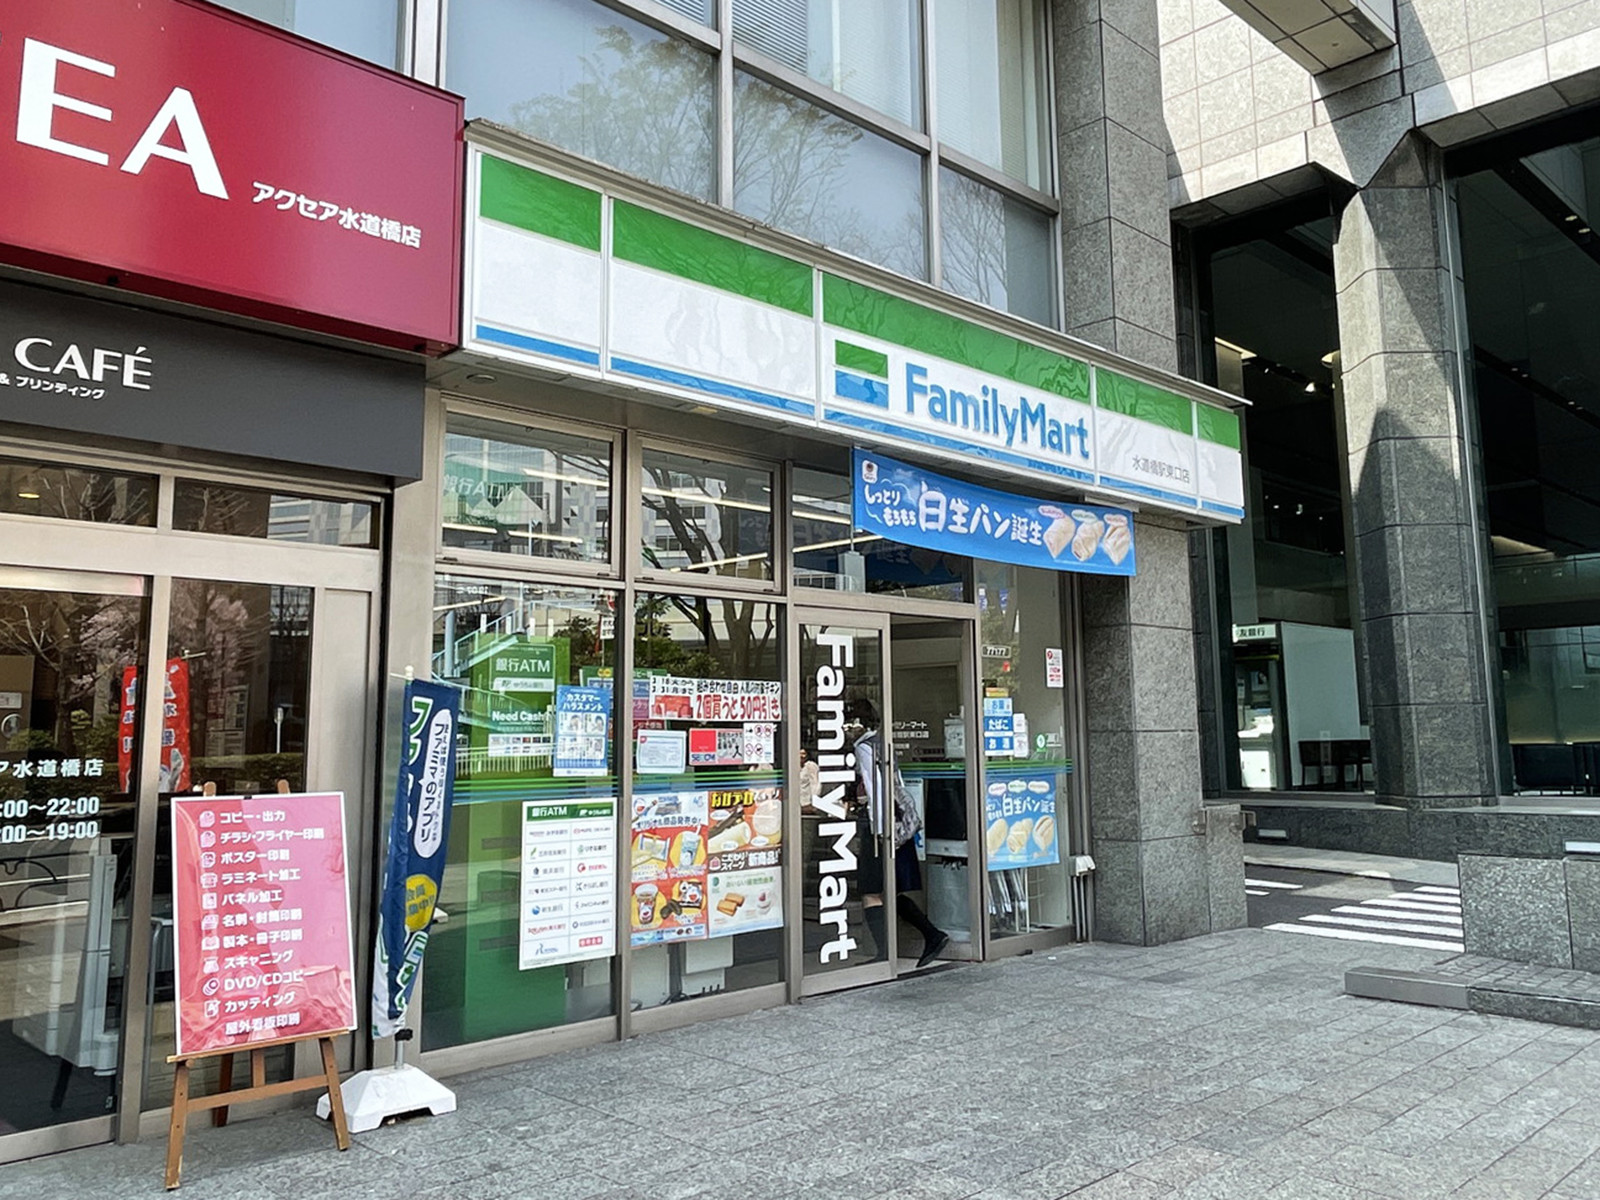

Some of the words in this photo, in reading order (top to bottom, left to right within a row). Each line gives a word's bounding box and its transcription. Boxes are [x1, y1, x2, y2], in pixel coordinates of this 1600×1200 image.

[16, 37, 230, 200] EA
[252, 181, 422, 249] アクセア水道橋店
[14, 337, 153, 390] CAFÉ
[15, 375, 106, 400] プリンティング
[904, 362, 1091, 460] FamilyMart
[864, 484, 901, 507] しっとり
[495, 657, 551, 672] 銀行ATM
[491, 710, 519, 722] Need
[562, 702, 604, 712] ハラスメント
[988, 719, 1010, 731] たばこ
[421, 722, 447, 843] ファミマのアプリ
[813, 632, 858, 964] FamilyMart
[219, 810, 286, 824] コピー・出力
[220, 827, 325, 844] チラシ・フライヤー印刷
[220, 849, 290, 864] ポスター印刷
[221, 868, 302, 886] ラミネート加工
[221, 889, 284, 906] パネル加工
[223, 949, 294, 970] スキャニング
[223, 969, 316, 992] DVD/CDコピー
[224, 990, 296, 1013] カッティング
